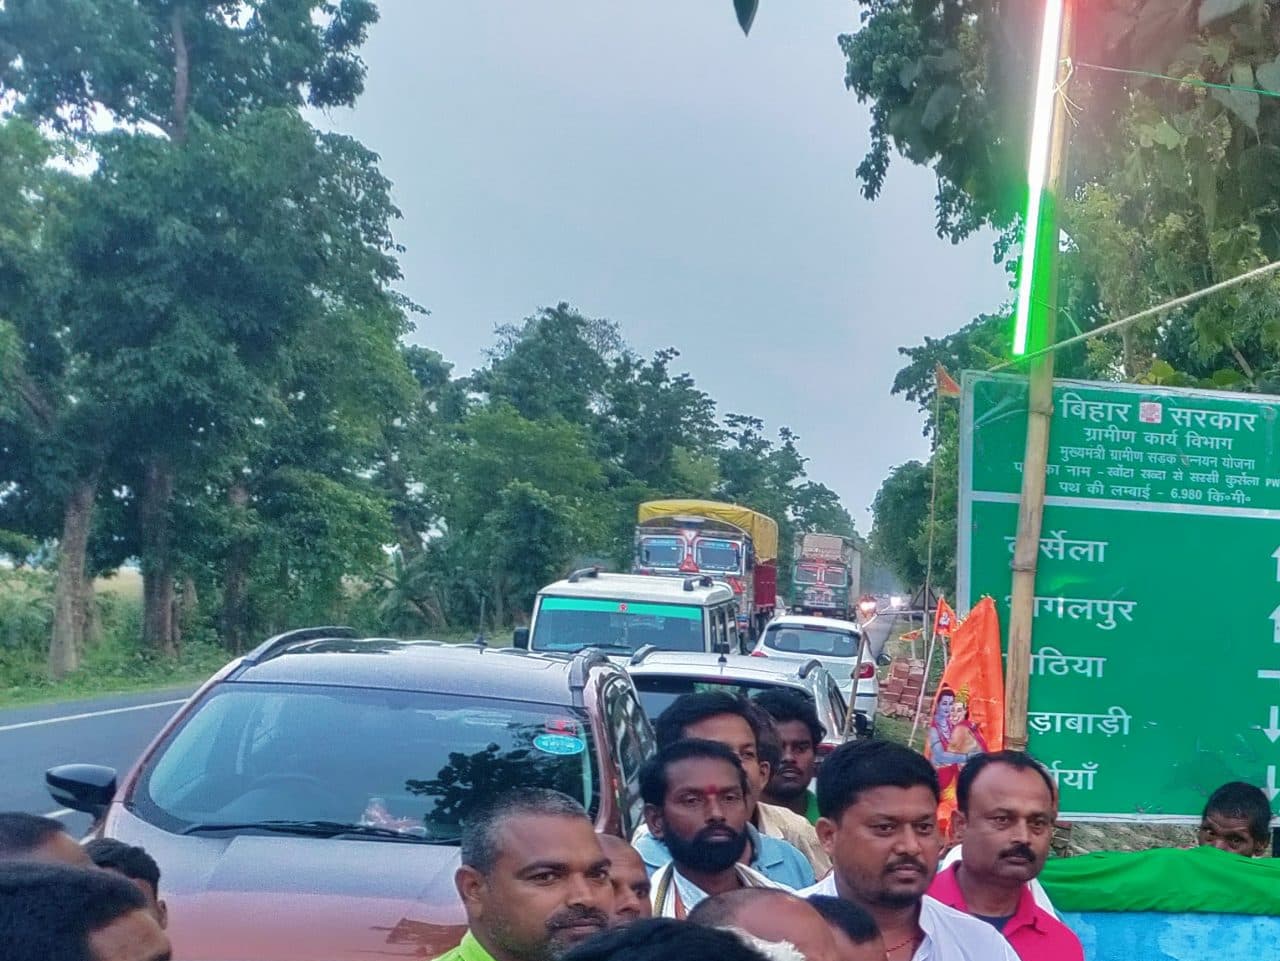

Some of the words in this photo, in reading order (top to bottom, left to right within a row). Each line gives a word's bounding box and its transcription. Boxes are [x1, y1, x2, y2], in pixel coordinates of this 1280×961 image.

[1059, 392, 1132, 422] बिहार
[1168, 407, 1259, 432] सरकार
[1084, 425, 1136, 443] ग्रामीण
[1143, 429, 1178, 446] कार्य
[1185, 431, 1234, 450] विभाग
[1060, 445, 1105, 462] मुख्यमंत्री
[1109, 447, 1143, 463] ग्रामीण
[1222, 454, 1255, 470] योजना
[1066, 466, 1091, 478] नाम
[1173, 468, 1183, 481] से
[1190, 470, 1219, 484] सरसी
[1059, 481, 1081, 493] पथ
[1086, 480, 1104, 495] की
[1110, 483, 1150, 499] लम्बाई
[1170, 488, 1202, 500] 6.980
